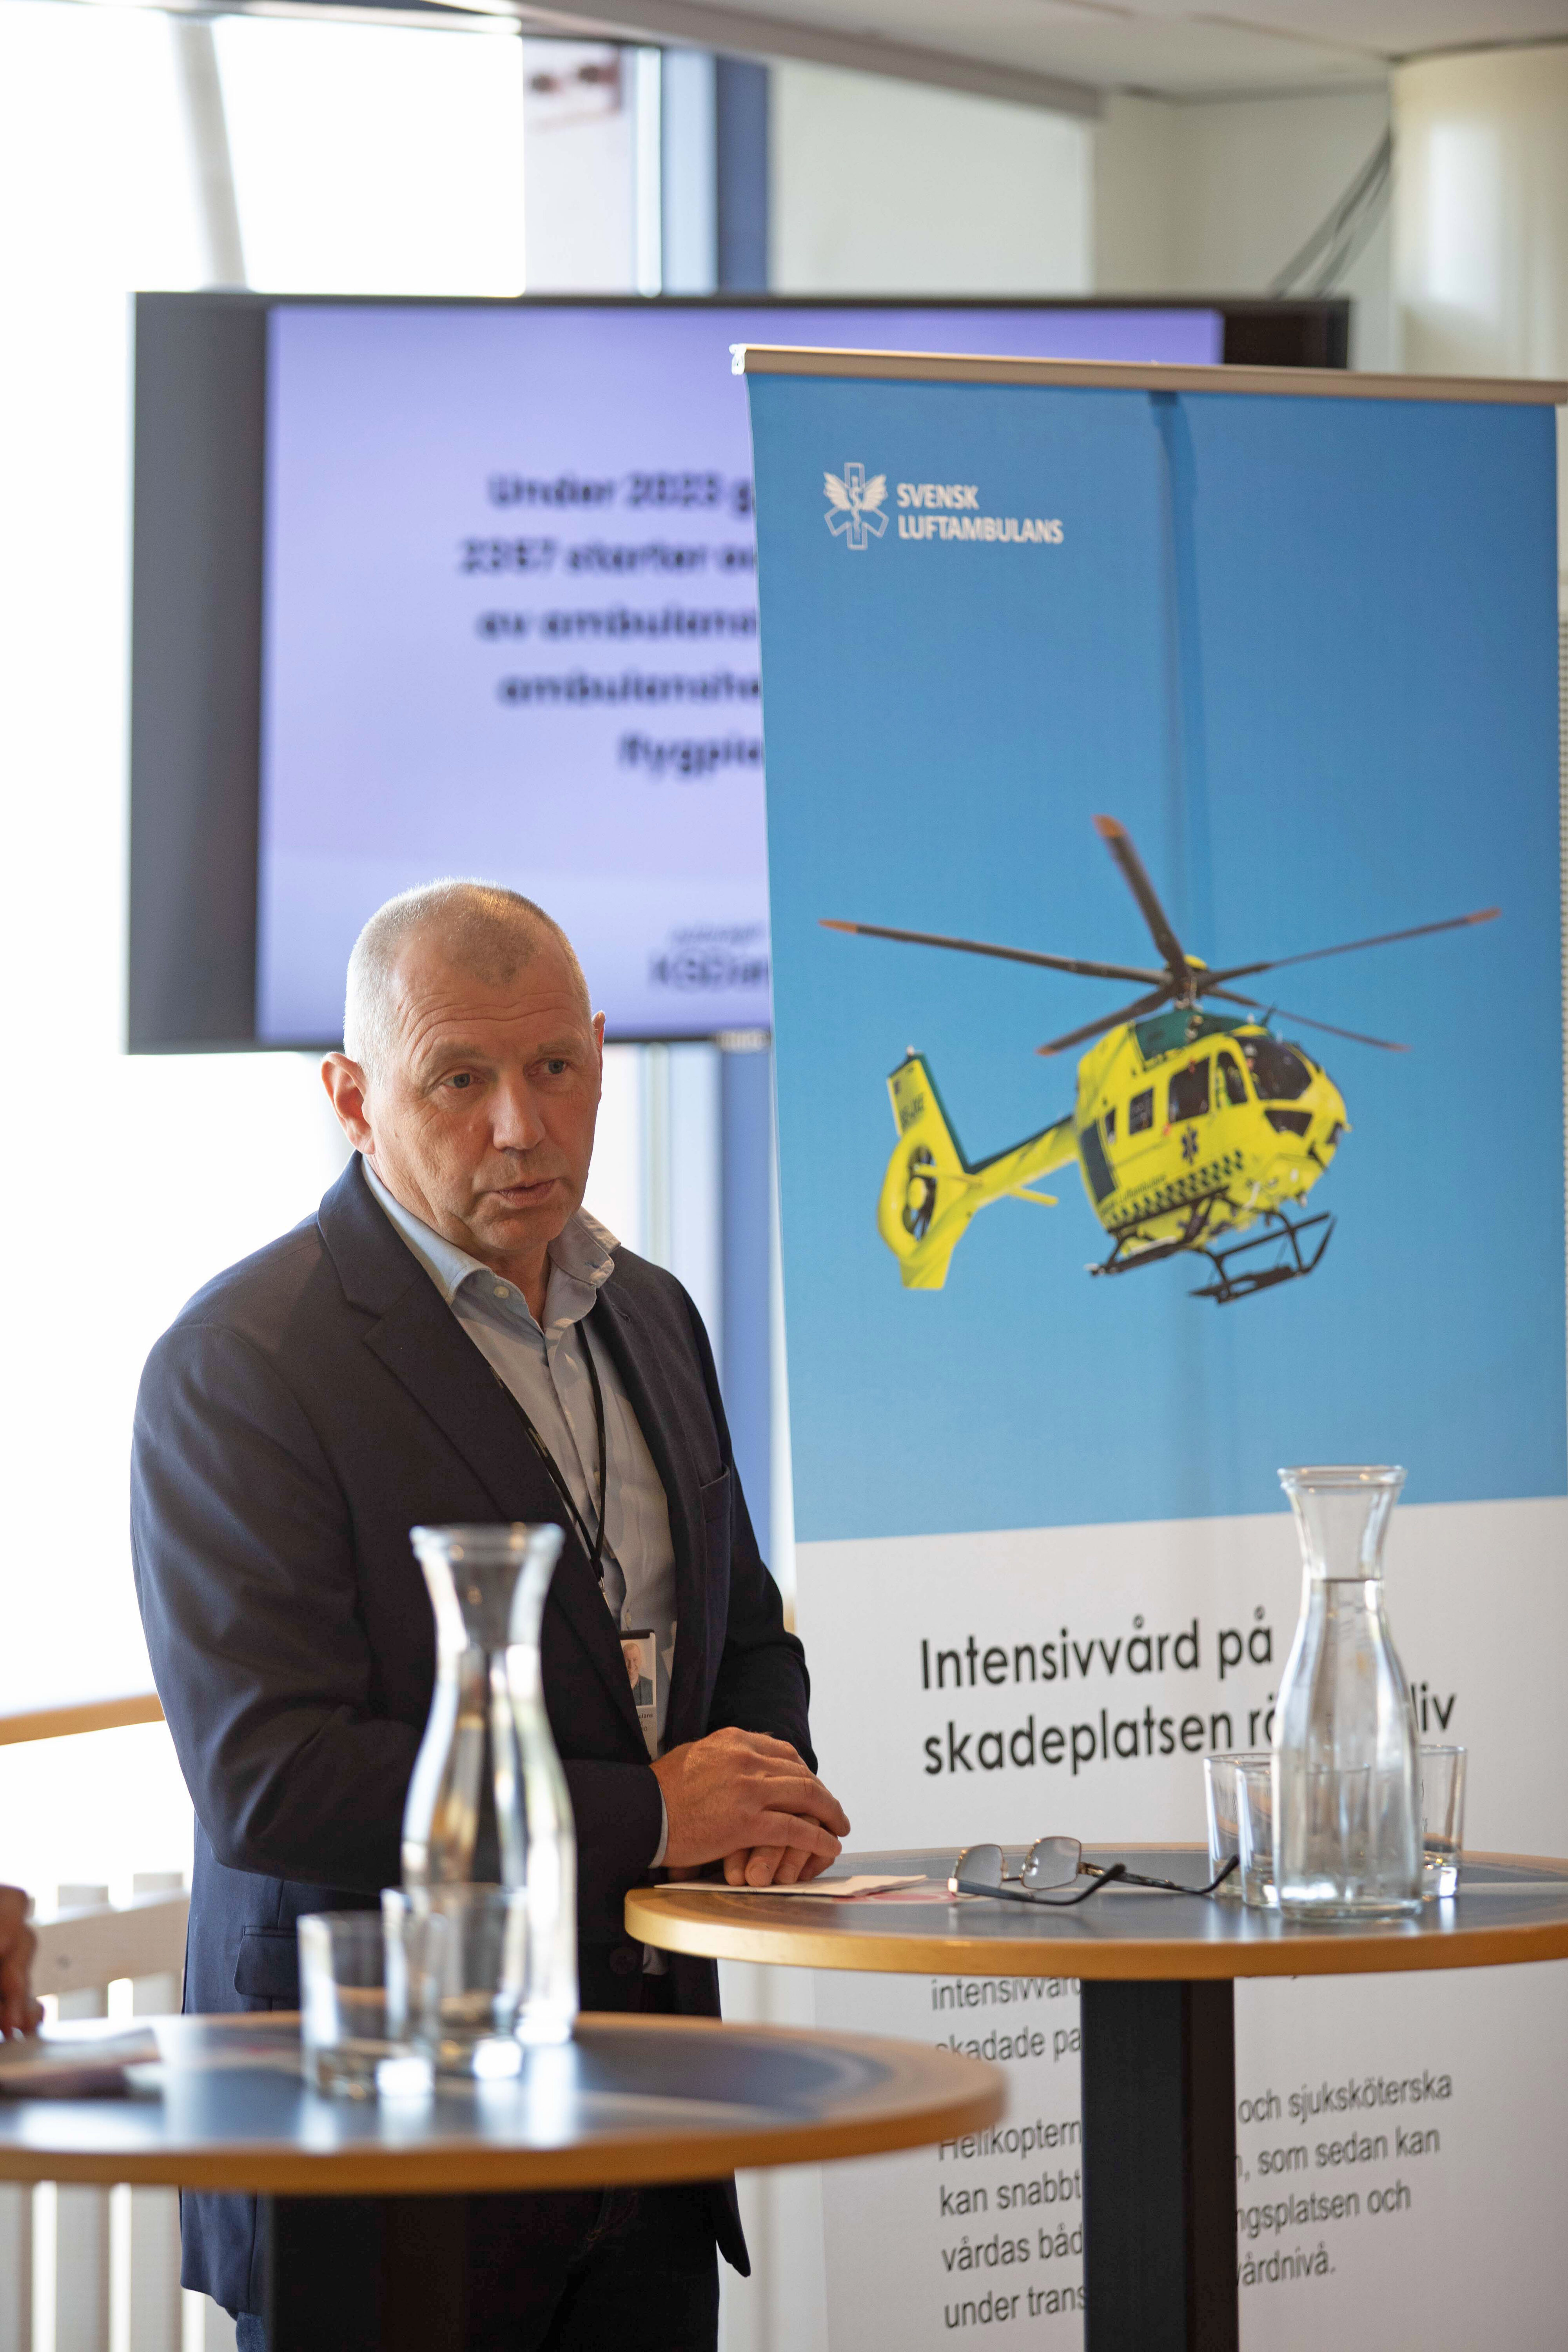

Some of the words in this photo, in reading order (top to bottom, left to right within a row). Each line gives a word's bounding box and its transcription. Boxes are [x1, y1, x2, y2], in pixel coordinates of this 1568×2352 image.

[491, 474, 617, 506] Under
[626, 474, 721, 507] 2023
[897, 483, 980, 510] SVENSK
[898, 515, 1064, 544] LUFTAMBULANS
[566, 543, 709, 572] starter
[922, 1614, 1199, 1689] Intensivvård
[1219, 1606, 1271, 1680] på
[924, 1705, 1232, 1777] skadeplatsen
[1238, 2088, 1281, 2123] och
[1288, 2069, 1452, 2125] sjuksköterska
[941, 2184, 988, 2217] kan
[997, 2168, 1081, 2210] snabbt
[1258, 2145, 1308, 2176] som
[1315, 2131, 1388, 2168] sedan
[1395, 2125, 1441, 2158] kan
[942, 2233, 1030, 2272] vårdas
[1367, 2178, 1411, 2215] och
[945, 2290, 1020, 2328] under
